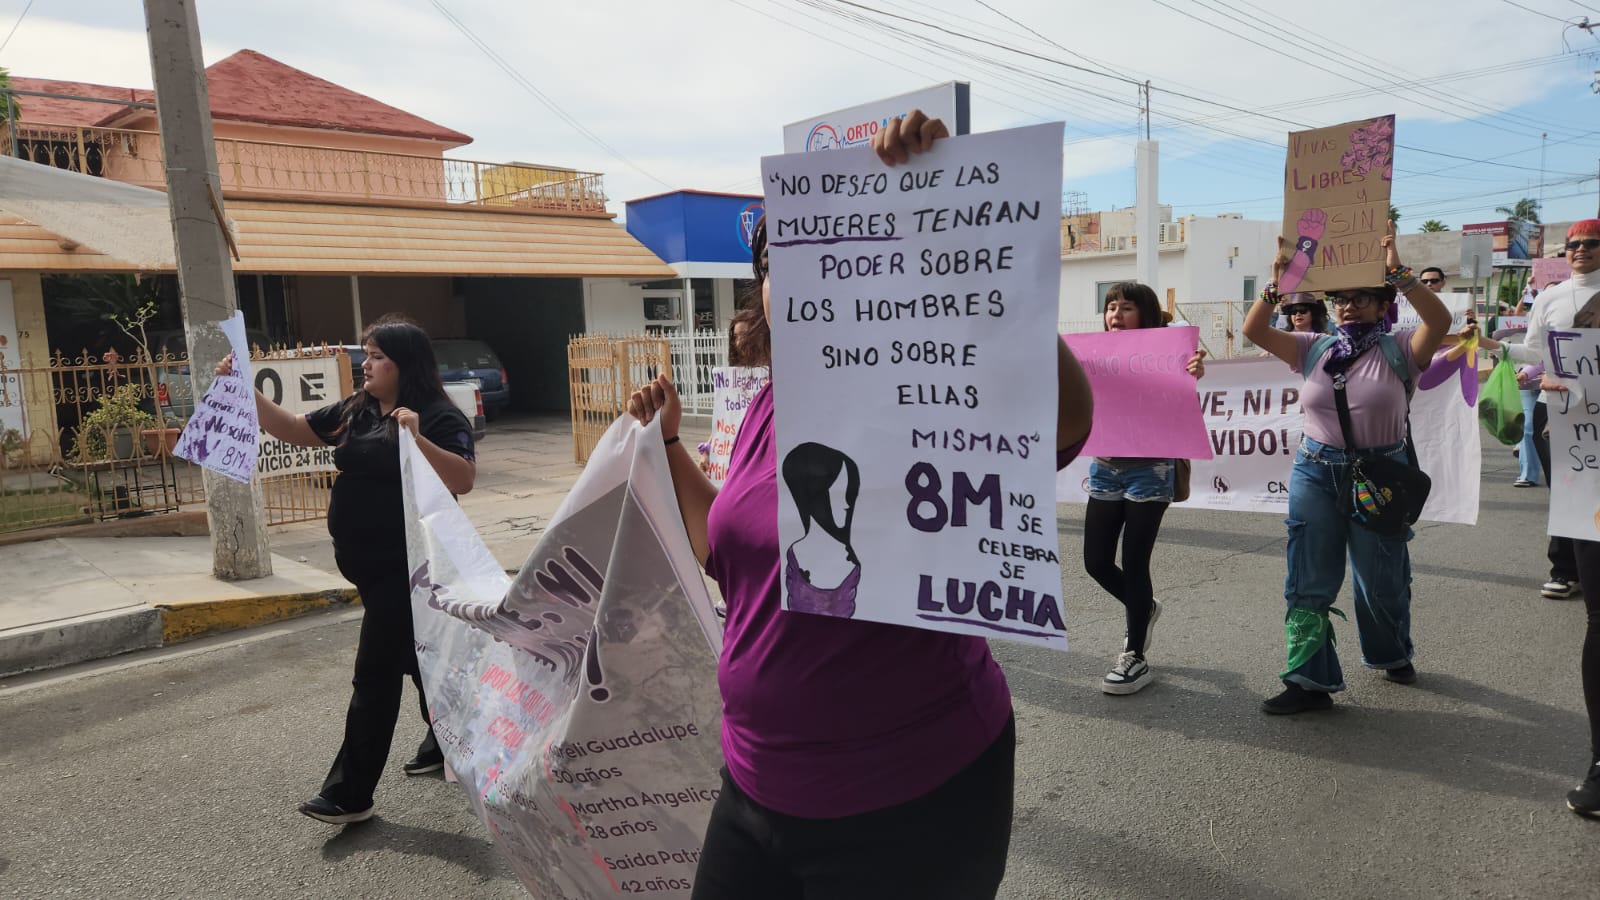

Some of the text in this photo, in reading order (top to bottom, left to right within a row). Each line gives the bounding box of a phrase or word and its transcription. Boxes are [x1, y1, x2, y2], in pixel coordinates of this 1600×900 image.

[846, 120, 878, 142] ORTO
[821, 172, 888, 197] DESEO
[899, 169, 945, 192] QUE
[954, 162, 1000, 188] LAS
[1293, 169, 1365, 191] LIBRES
[777, 200, 1041, 237] MUJERES TENGAN
[1331, 208, 1374, 233] SIN
[819, 245, 1014, 279] PODER SOBRE
[1322, 238, 1383, 270] MIEDO
[787, 289, 1005, 323] LOS HOMBRES
[822, 340, 977, 369] SINO SOBRE
[897, 384, 979, 409] ELLAS
[1243, 388, 1271, 416] NI
[716, 419, 736, 436] Nos
[1210, 429, 1290, 456] VIDO!
[221, 446, 247, 469] 8M
[296, 453, 311, 467] 24
[905, 461, 1035, 533] 8M NO
[1017, 514, 1043, 535] SE
[978, 537, 1059, 564] CELEBRA
[1000, 561, 1026, 580] SE
[917, 574, 1067, 631] LUCHA
[587, 722, 699, 754] Guadalupe
[552, 765, 623, 784] 30 años
[571, 794, 639, 816] Martha
[585, 819, 658, 839] 28 años
[604, 851, 658, 870] Saida
[621, 876, 691, 894] 42 años
